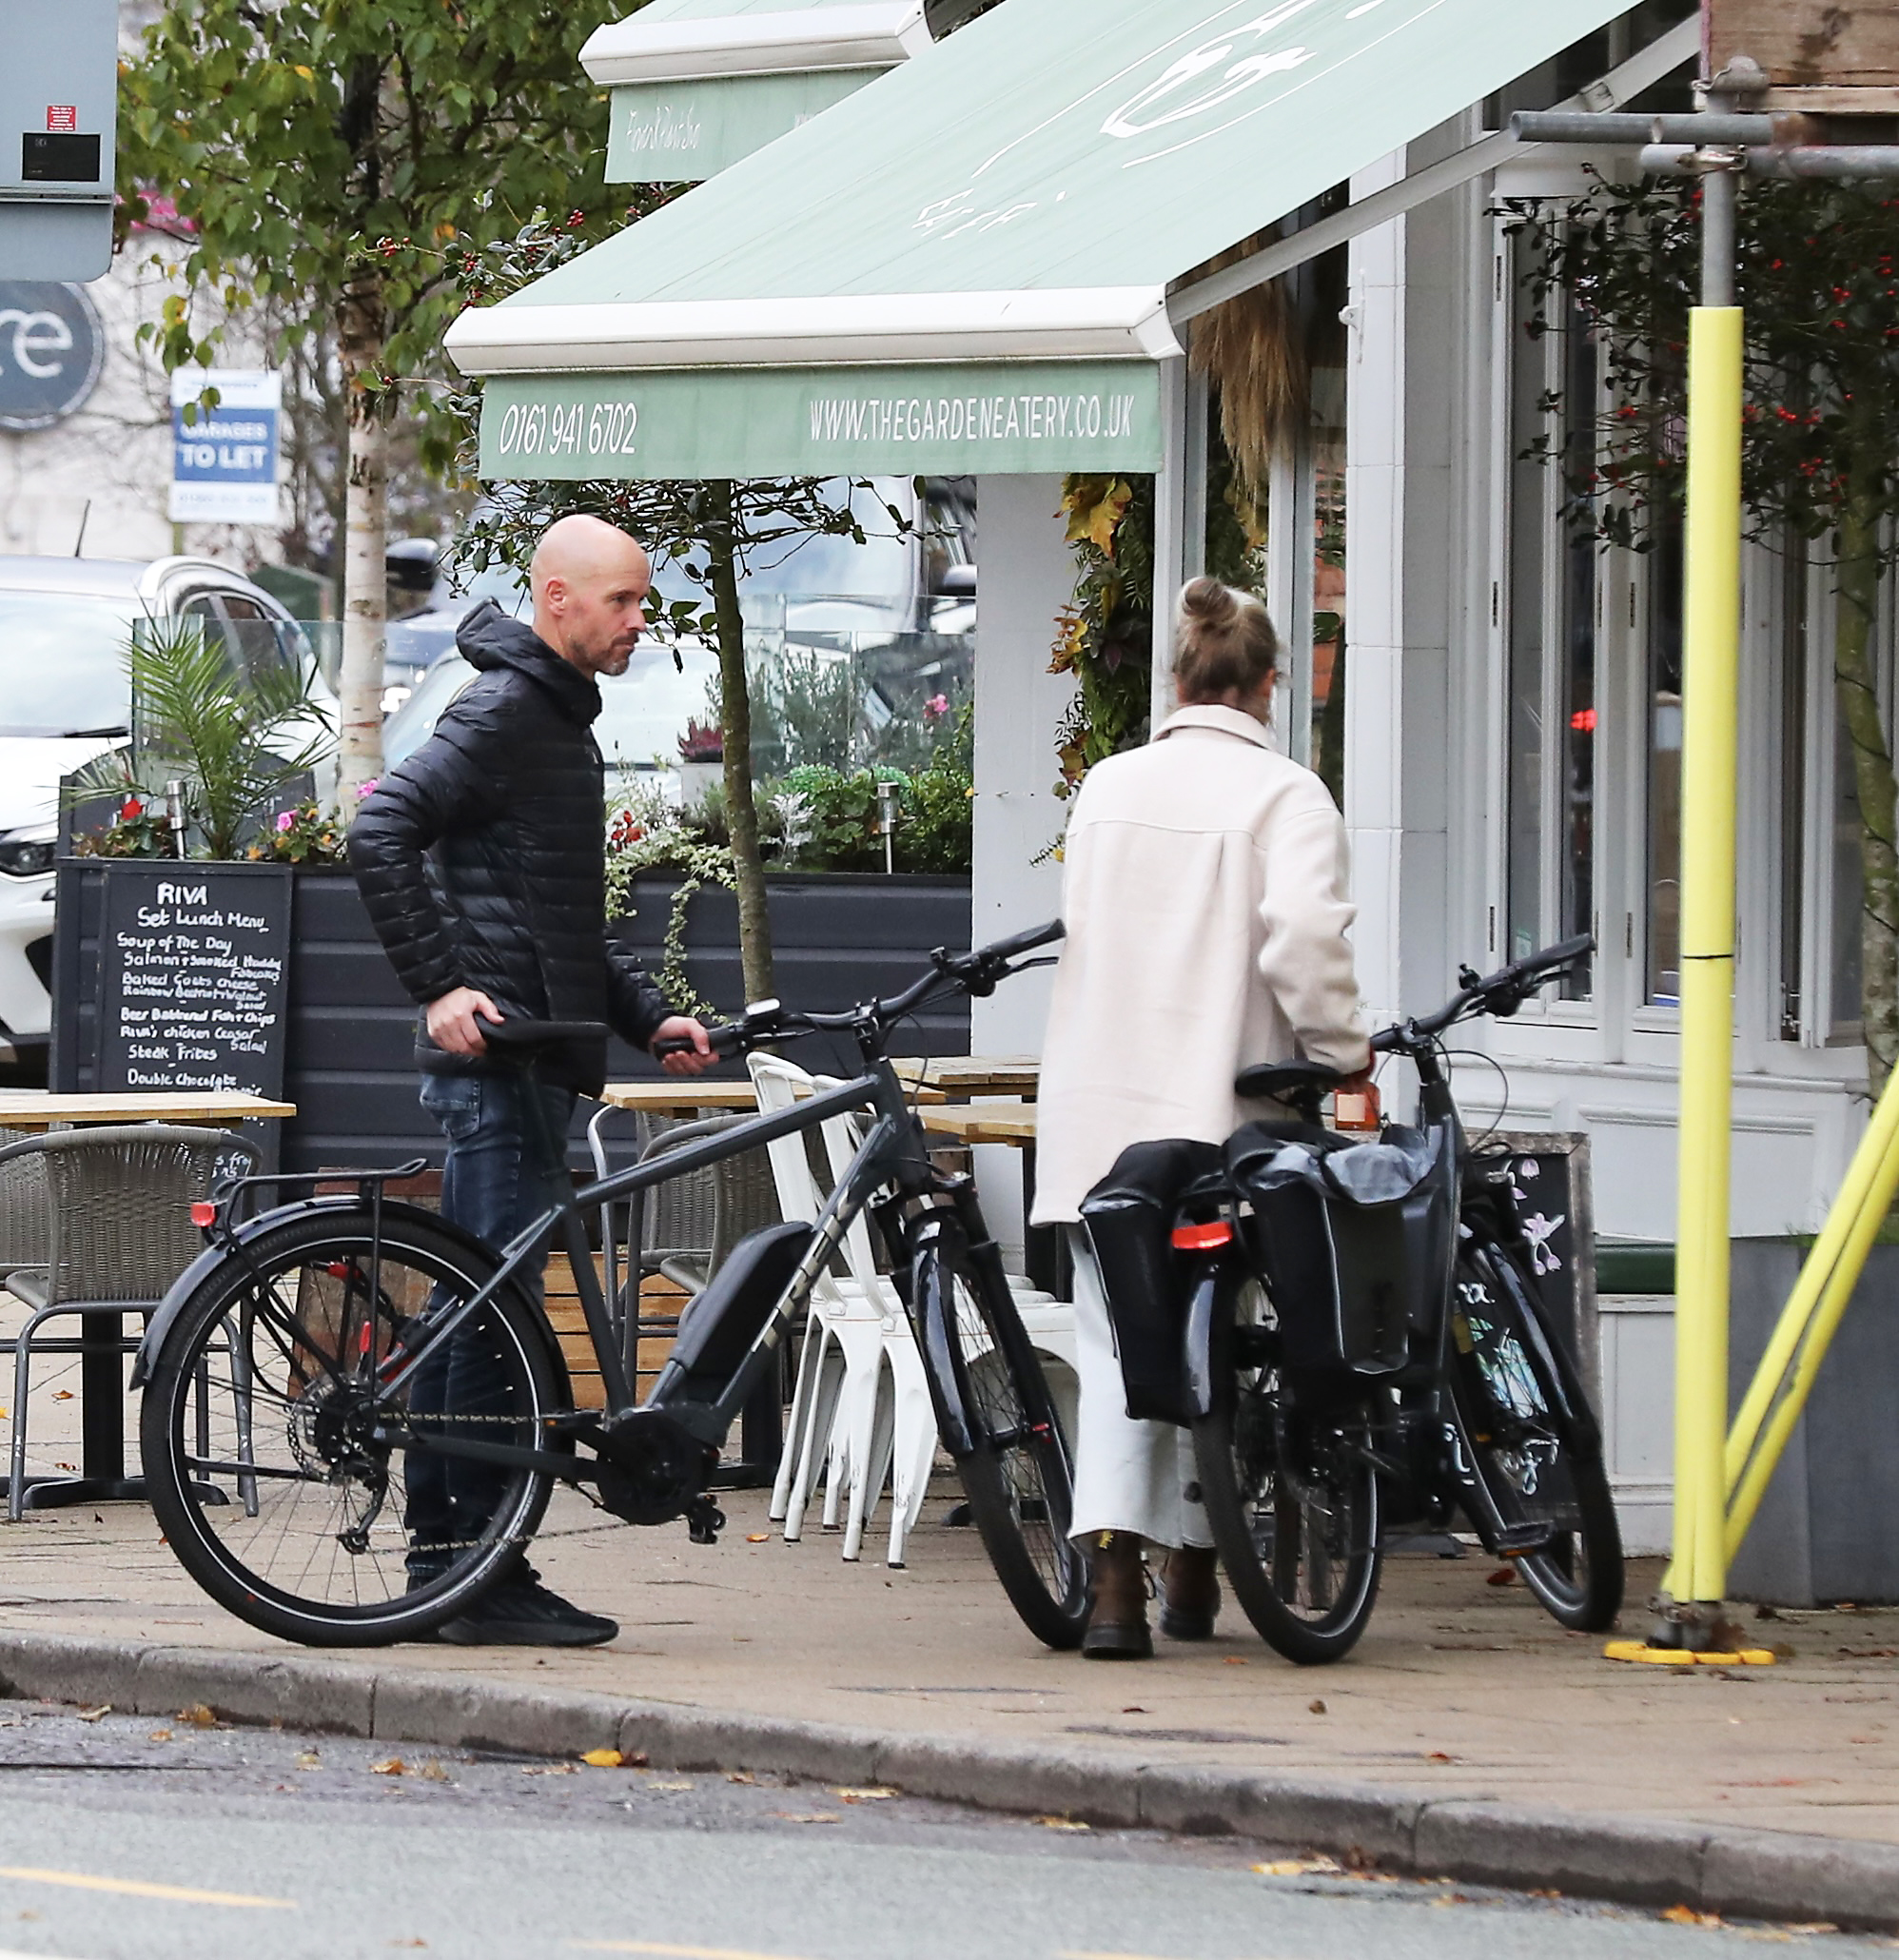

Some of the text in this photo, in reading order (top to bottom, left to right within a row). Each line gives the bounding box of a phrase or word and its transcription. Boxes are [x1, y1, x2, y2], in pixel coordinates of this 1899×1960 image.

[499, 402, 637, 455] 0161 941 6702
[810, 394, 1136, 441] WWW.THEGARDENEATERY.CO.UK
[177, 442, 268, 470] TO LET
[157, 881, 207, 905] RIVA
[137, 906, 265, 929] Set Lunch Menu
[116, 931, 232, 958] Soup of The Day
[124, 951, 179, 967] Salmon
[122, 970, 168, 986] Baked
[120, 1006, 149, 1022] Beer
[127, 1044, 218, 1061] Steak Frites
[230, 1040, 267, 1055] Salad
[127, 1068, 173, 1086] Double
[749, 1184, 854, 1353] TREK
